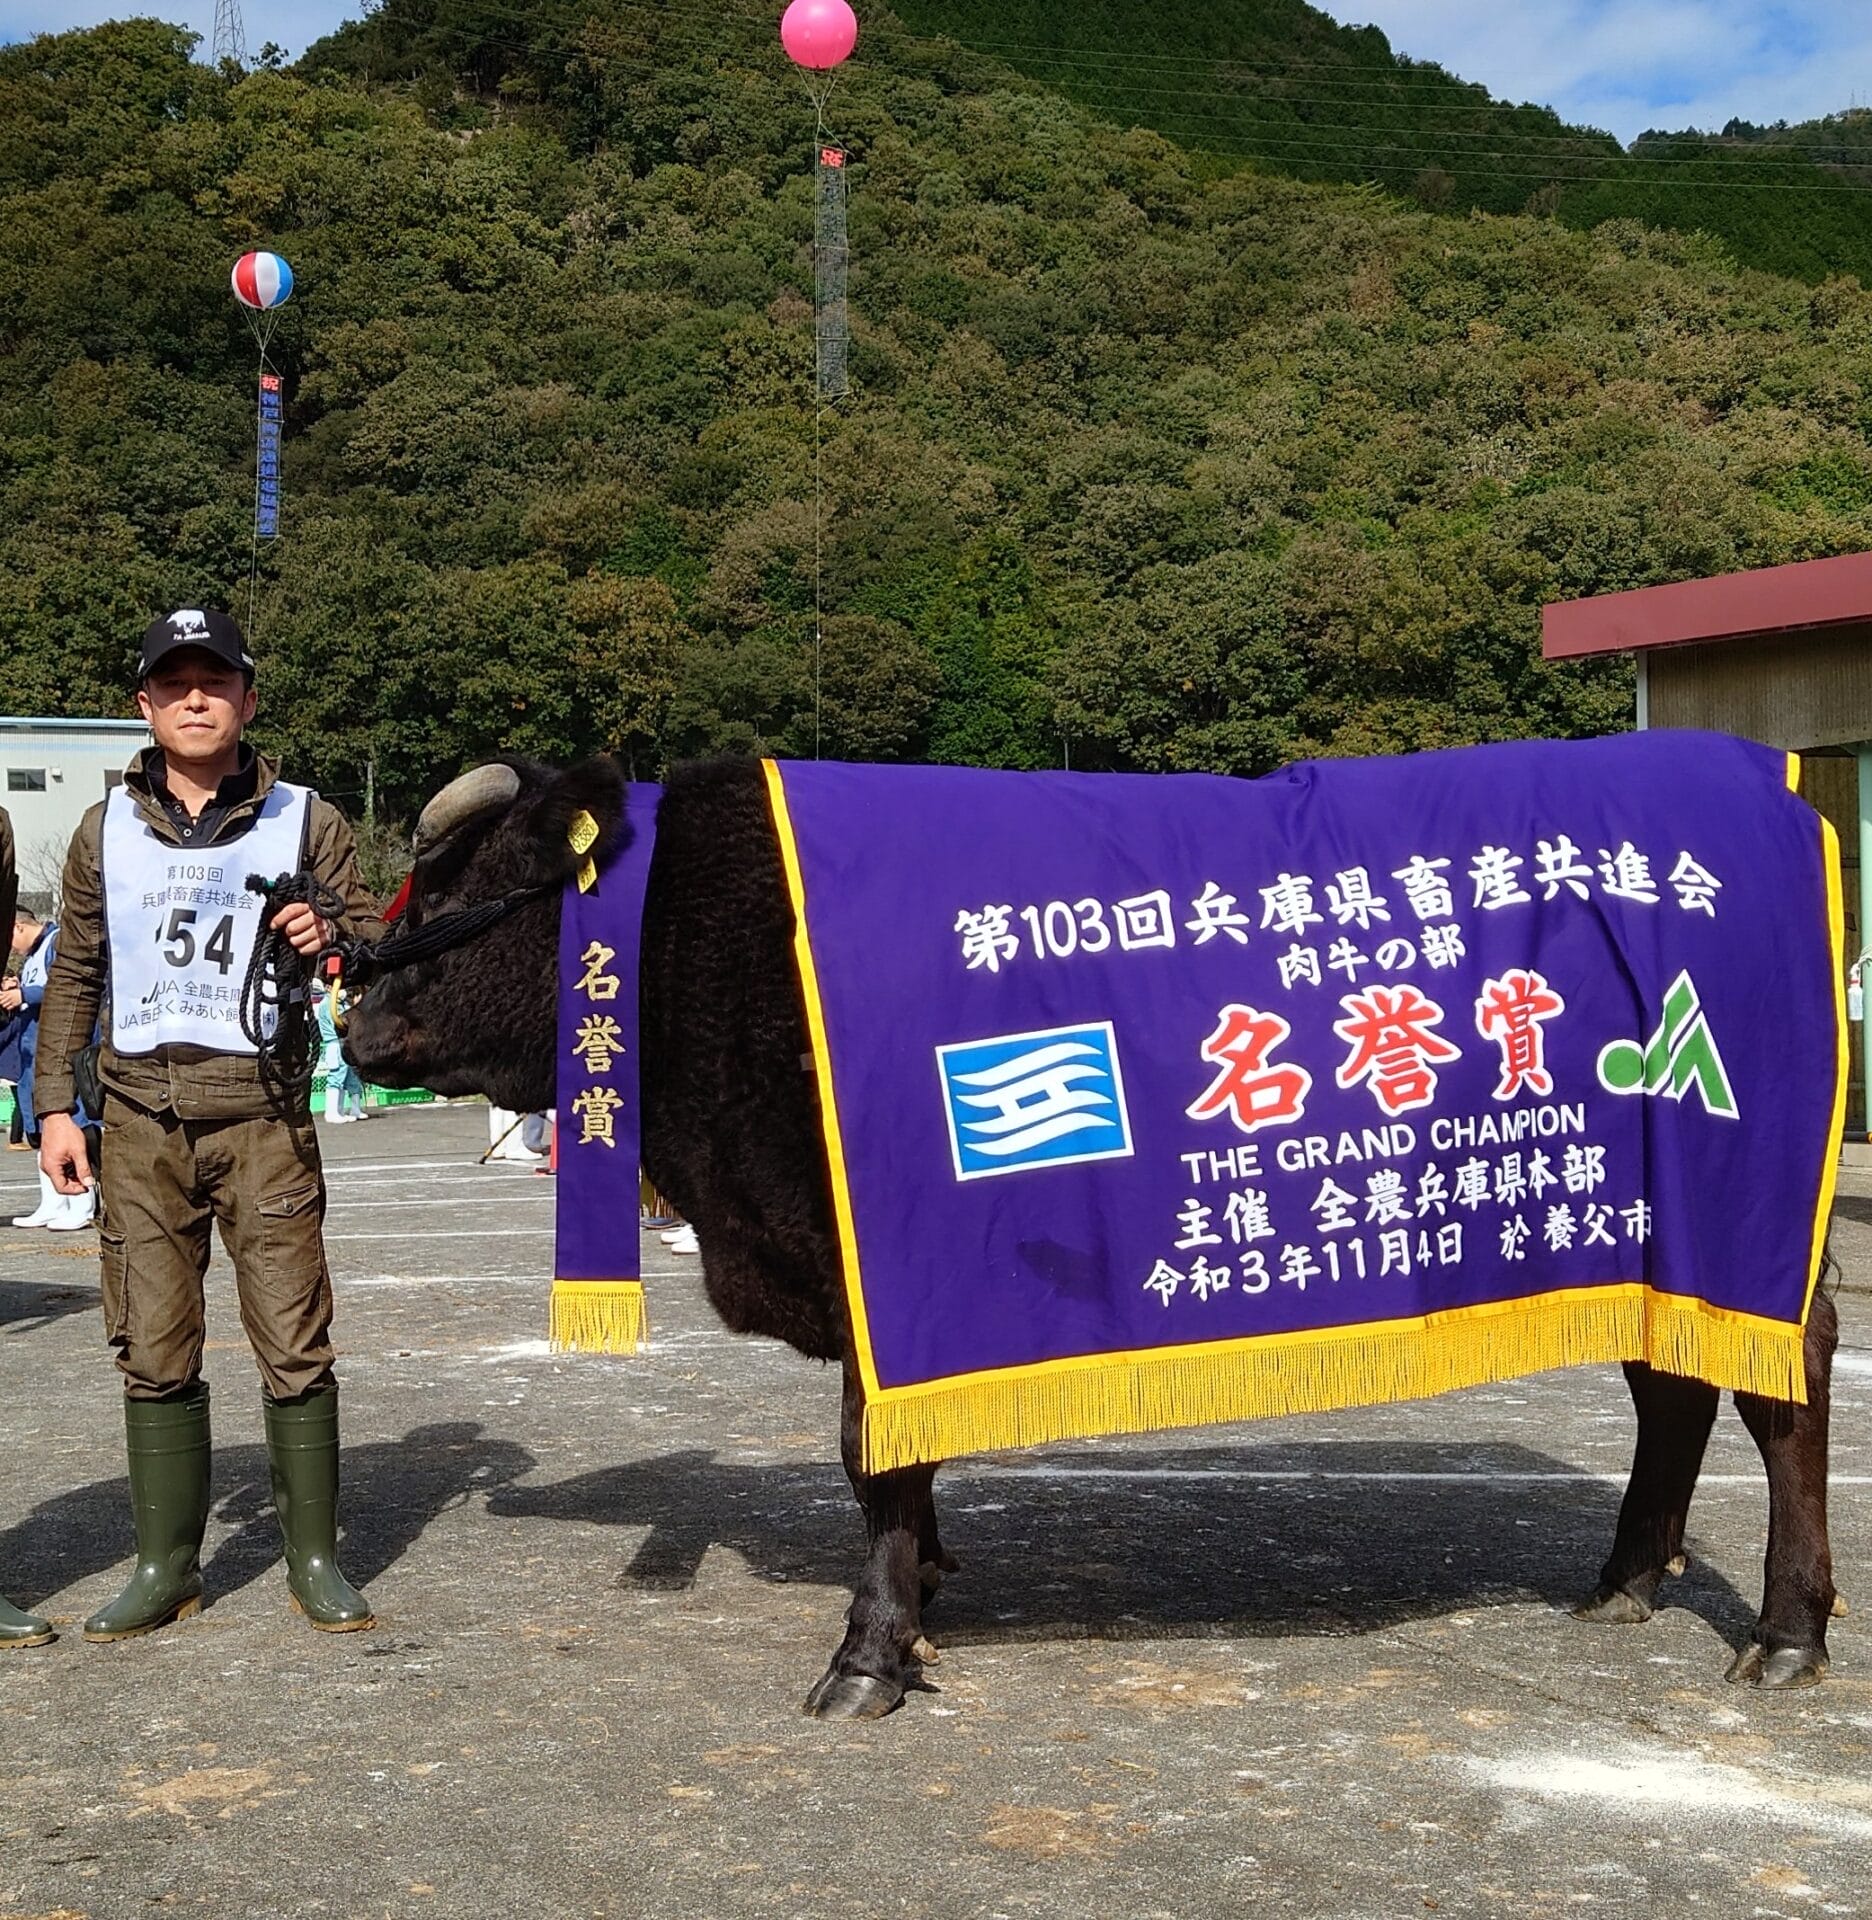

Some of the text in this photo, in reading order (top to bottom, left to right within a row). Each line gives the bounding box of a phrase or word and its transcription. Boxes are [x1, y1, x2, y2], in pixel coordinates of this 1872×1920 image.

[155, 907, 235, 975] 54
[954, 834, 1723, 973] 第103回兵庫県畜産共進会
[1277, 923, 1466, 990] 肉牛の部
[572, 940, 626, 1148] 名誉賞
[1185, 968, 1566, 1134] 名誉賞
[1181, 1102, 1585, 1184] THE GRAND CHAMPION
[1173, 1143, 1607, 1250] 主催 全農兵庫県本部
[1143, 1222, 1463, 1307] 令和3年11月4日
